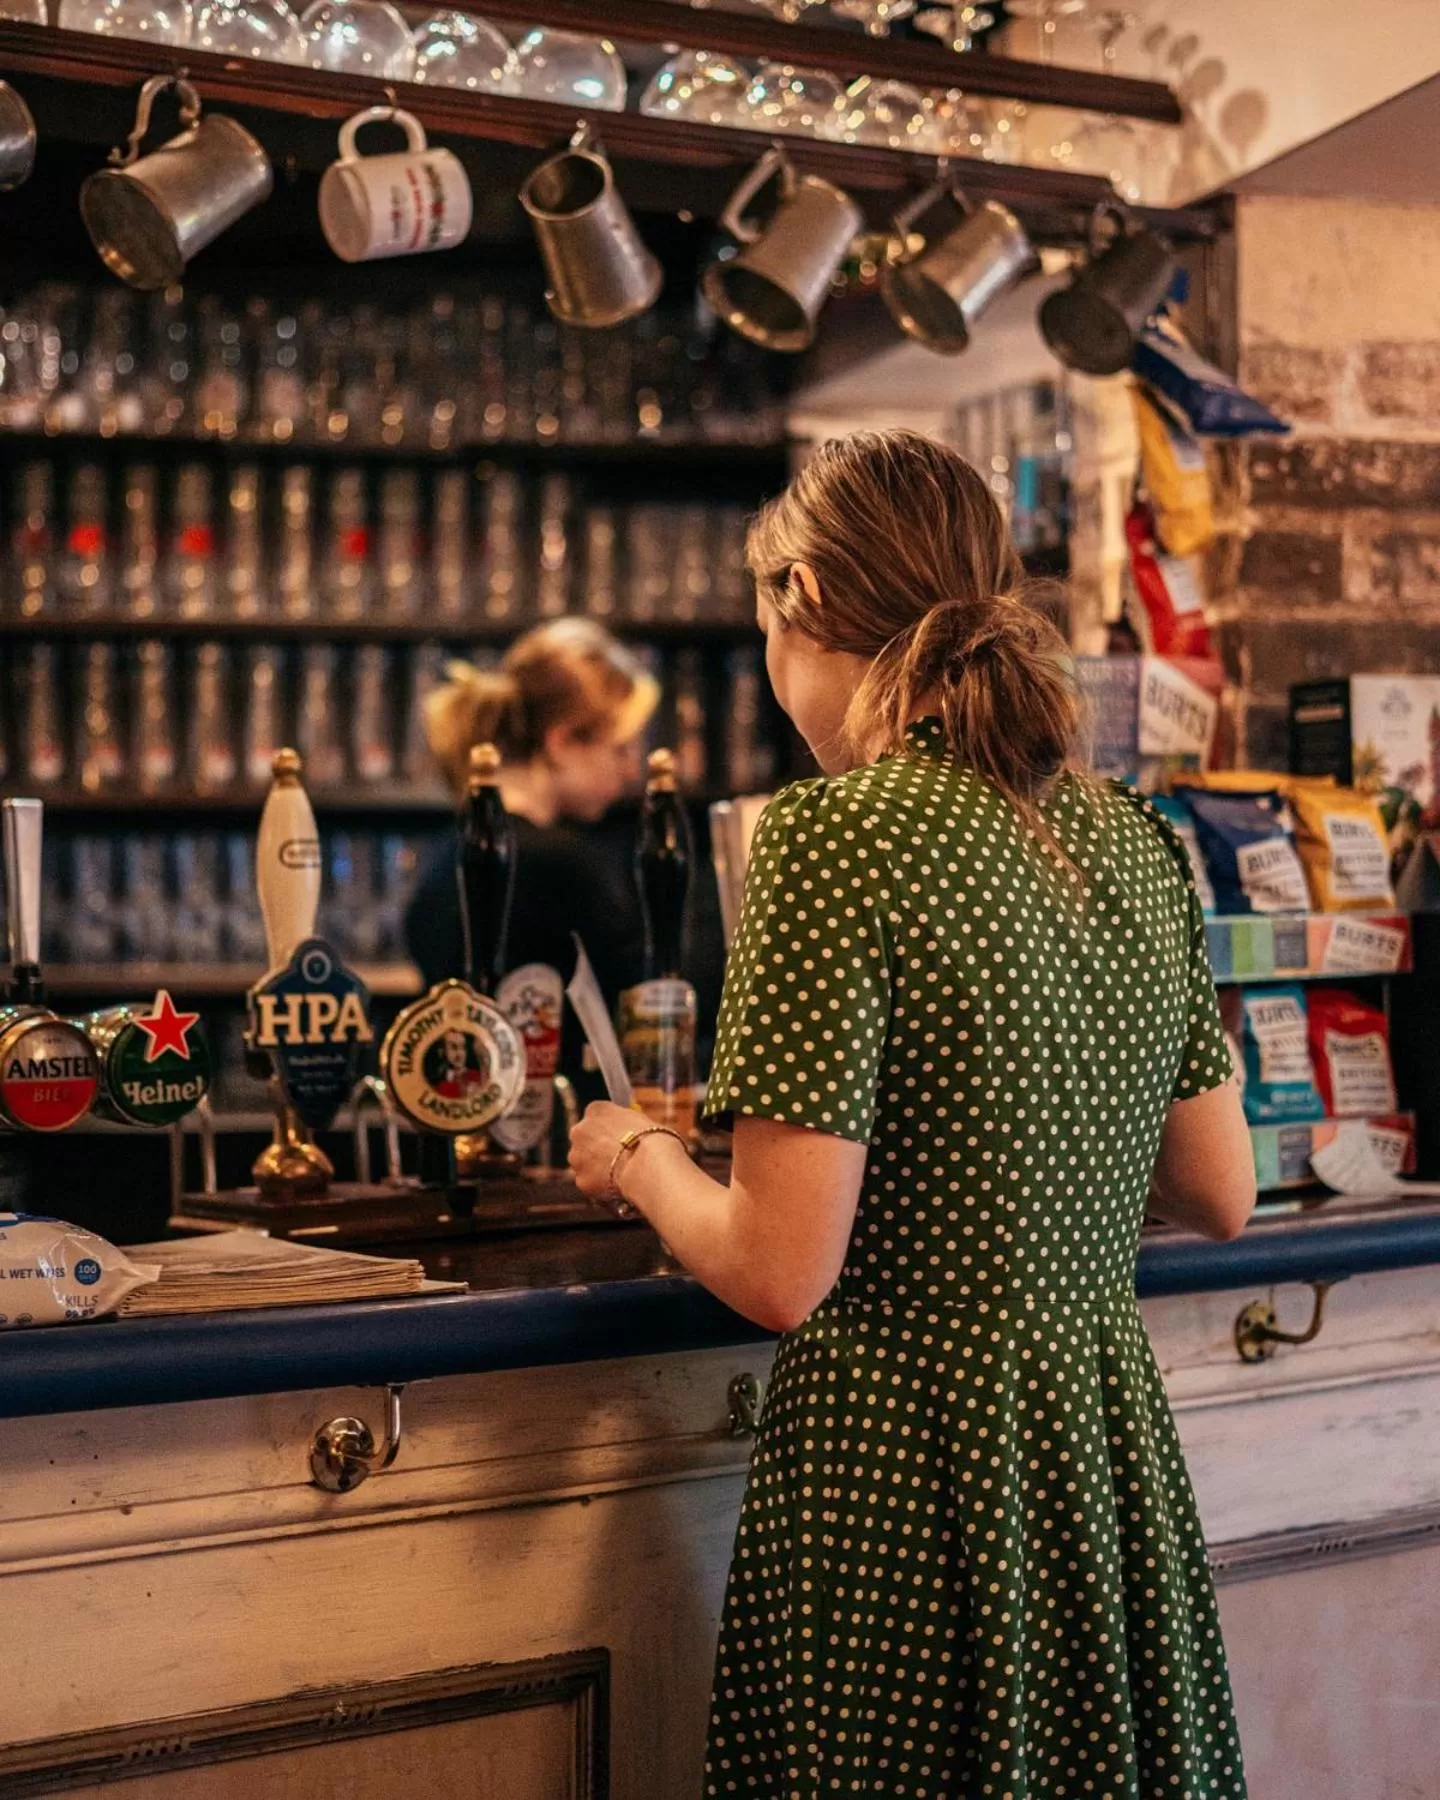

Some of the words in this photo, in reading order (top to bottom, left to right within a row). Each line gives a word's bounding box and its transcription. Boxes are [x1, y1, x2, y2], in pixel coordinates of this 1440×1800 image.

[257, 992, 374, 1046] HPA
[398, 1009, 444, 1078] TIMOTHY
[7, 1055, 92, 1079] AMSTEL
[418, 1082, 502, 1121] LANDLORD
[9, 1268, 32, 1279] WET
[77, 1264, 97, 1275] 100
[65, 1295, 99, 1308] KILLS
